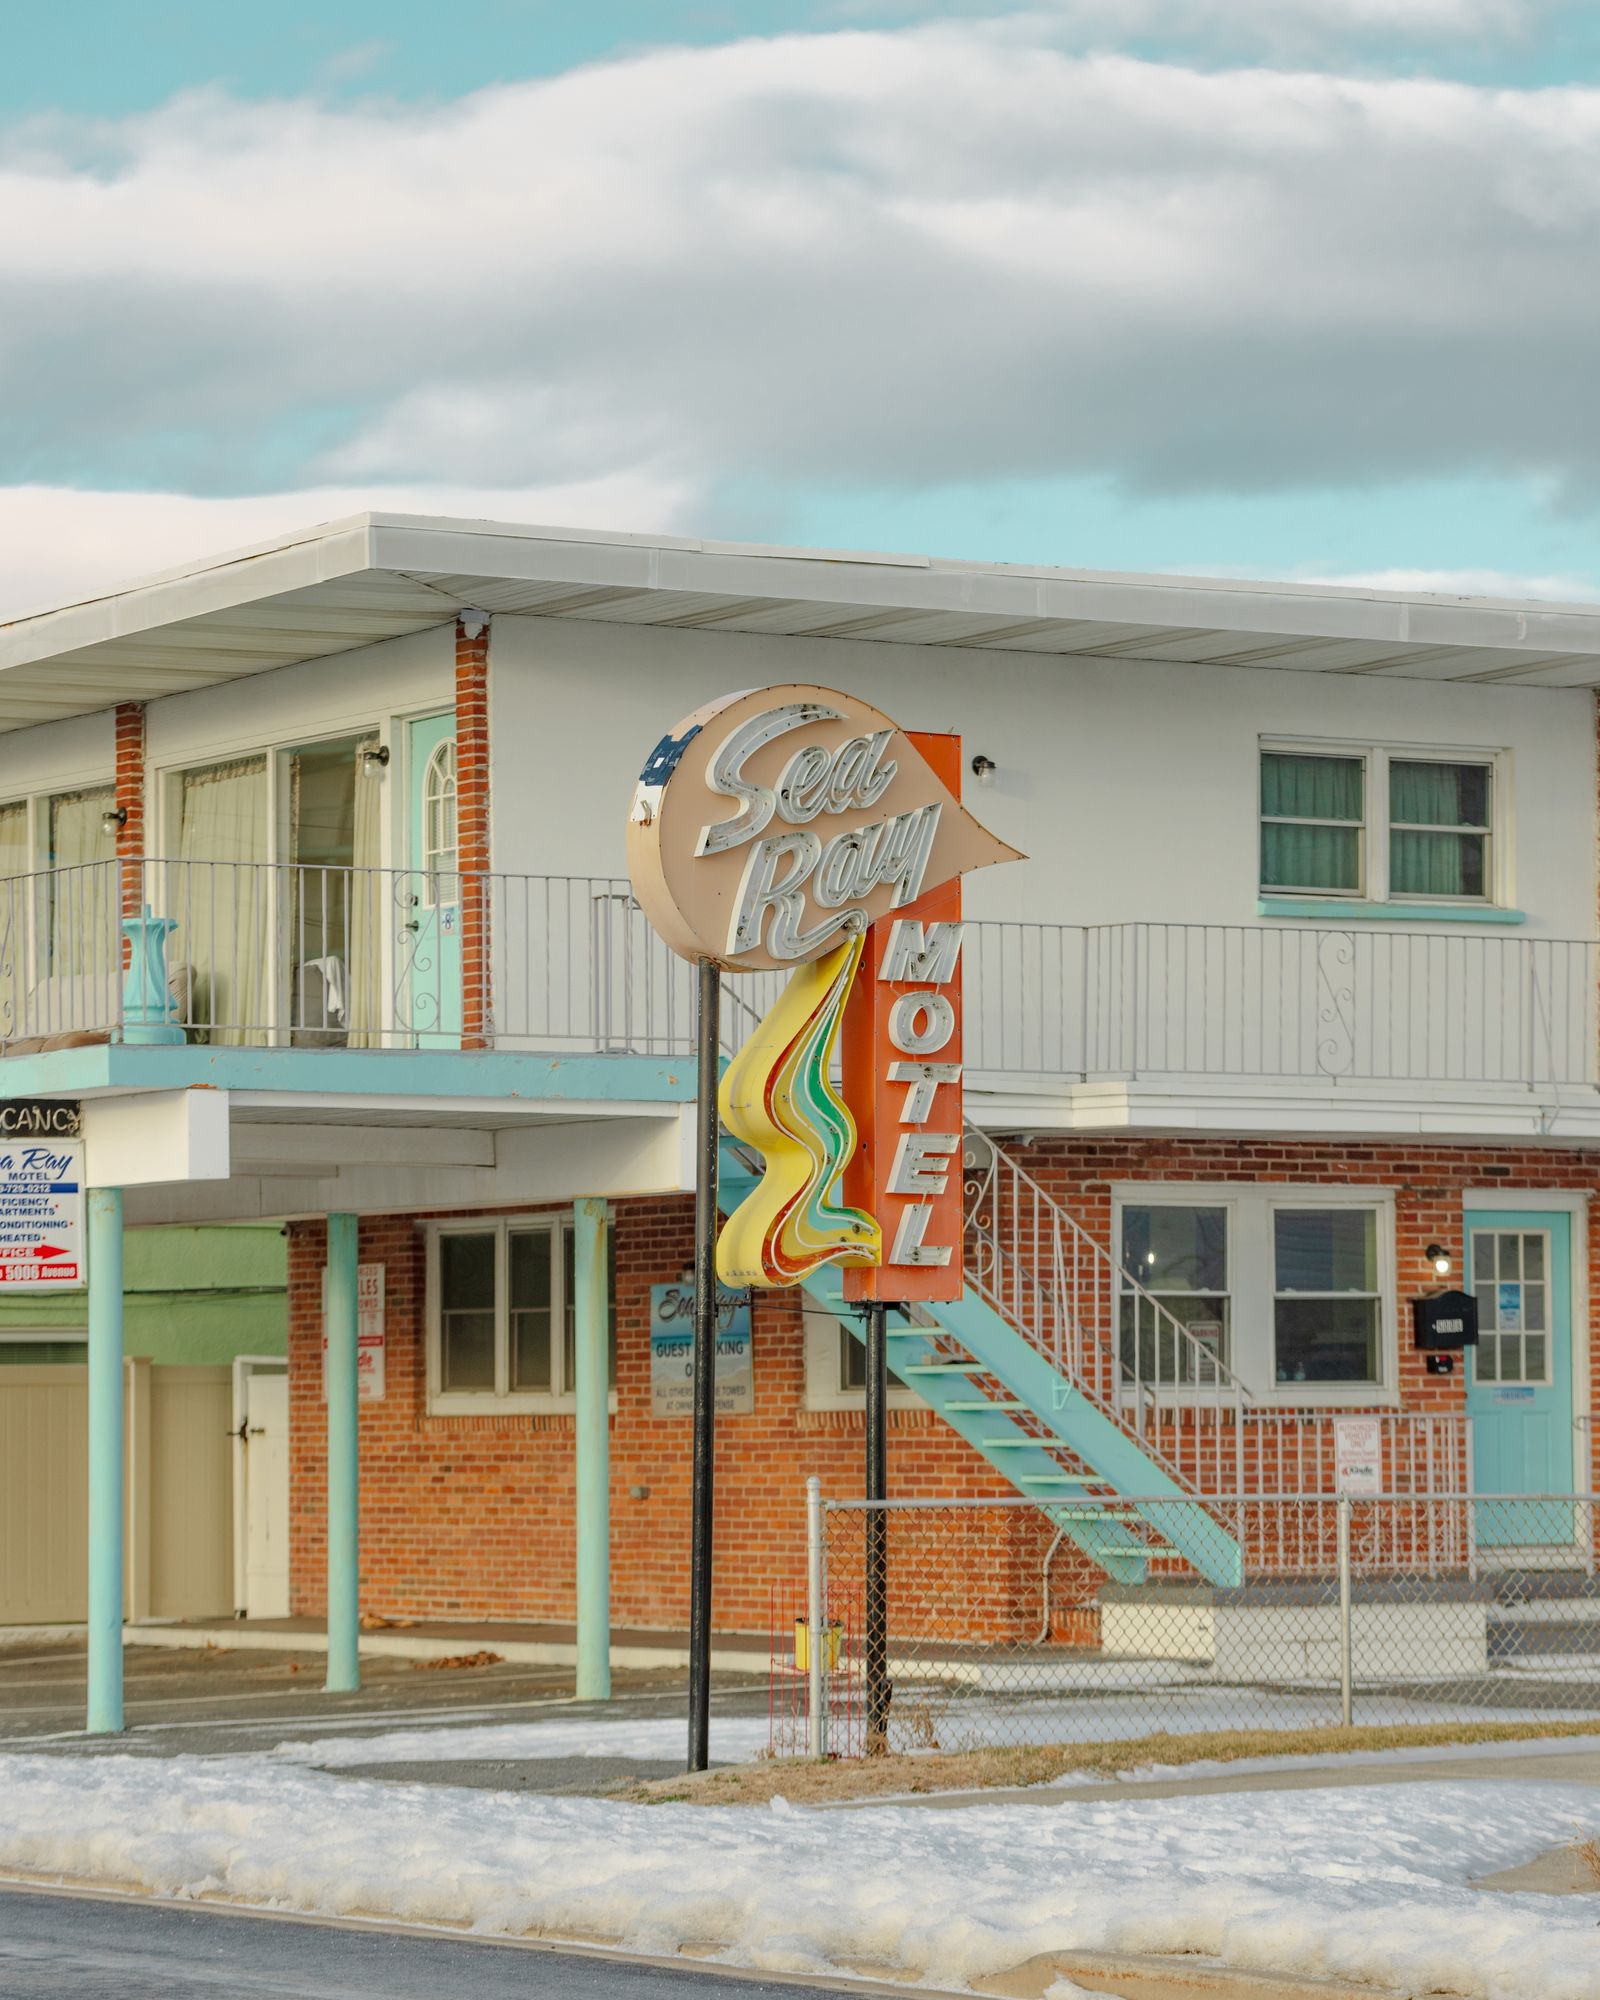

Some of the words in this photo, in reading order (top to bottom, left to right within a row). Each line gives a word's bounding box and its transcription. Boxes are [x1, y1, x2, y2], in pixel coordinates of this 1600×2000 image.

[694, 704, 898, 858] Sea
[726, 801, 943, 960] Ray
[878, 919, 966, 1266] MOTEL
[0, 1106, 82, 1132] CANCY
[22, 1148, 73, 1180] Ray
[9, 1172, 50, 1181] MOTEL
[0, 1198, 49, 1206] FICIENCY
[6, 1264, 39, 1281] 5006
[41, 1266, 76, 1278] Avenue
[656, 1343, 691, 1358] GUEST
[715, 1341, 744, 1356] KING
[656, 1388, 667, 1398] ALL
[722, 1385, 746, 1396] TOWED
